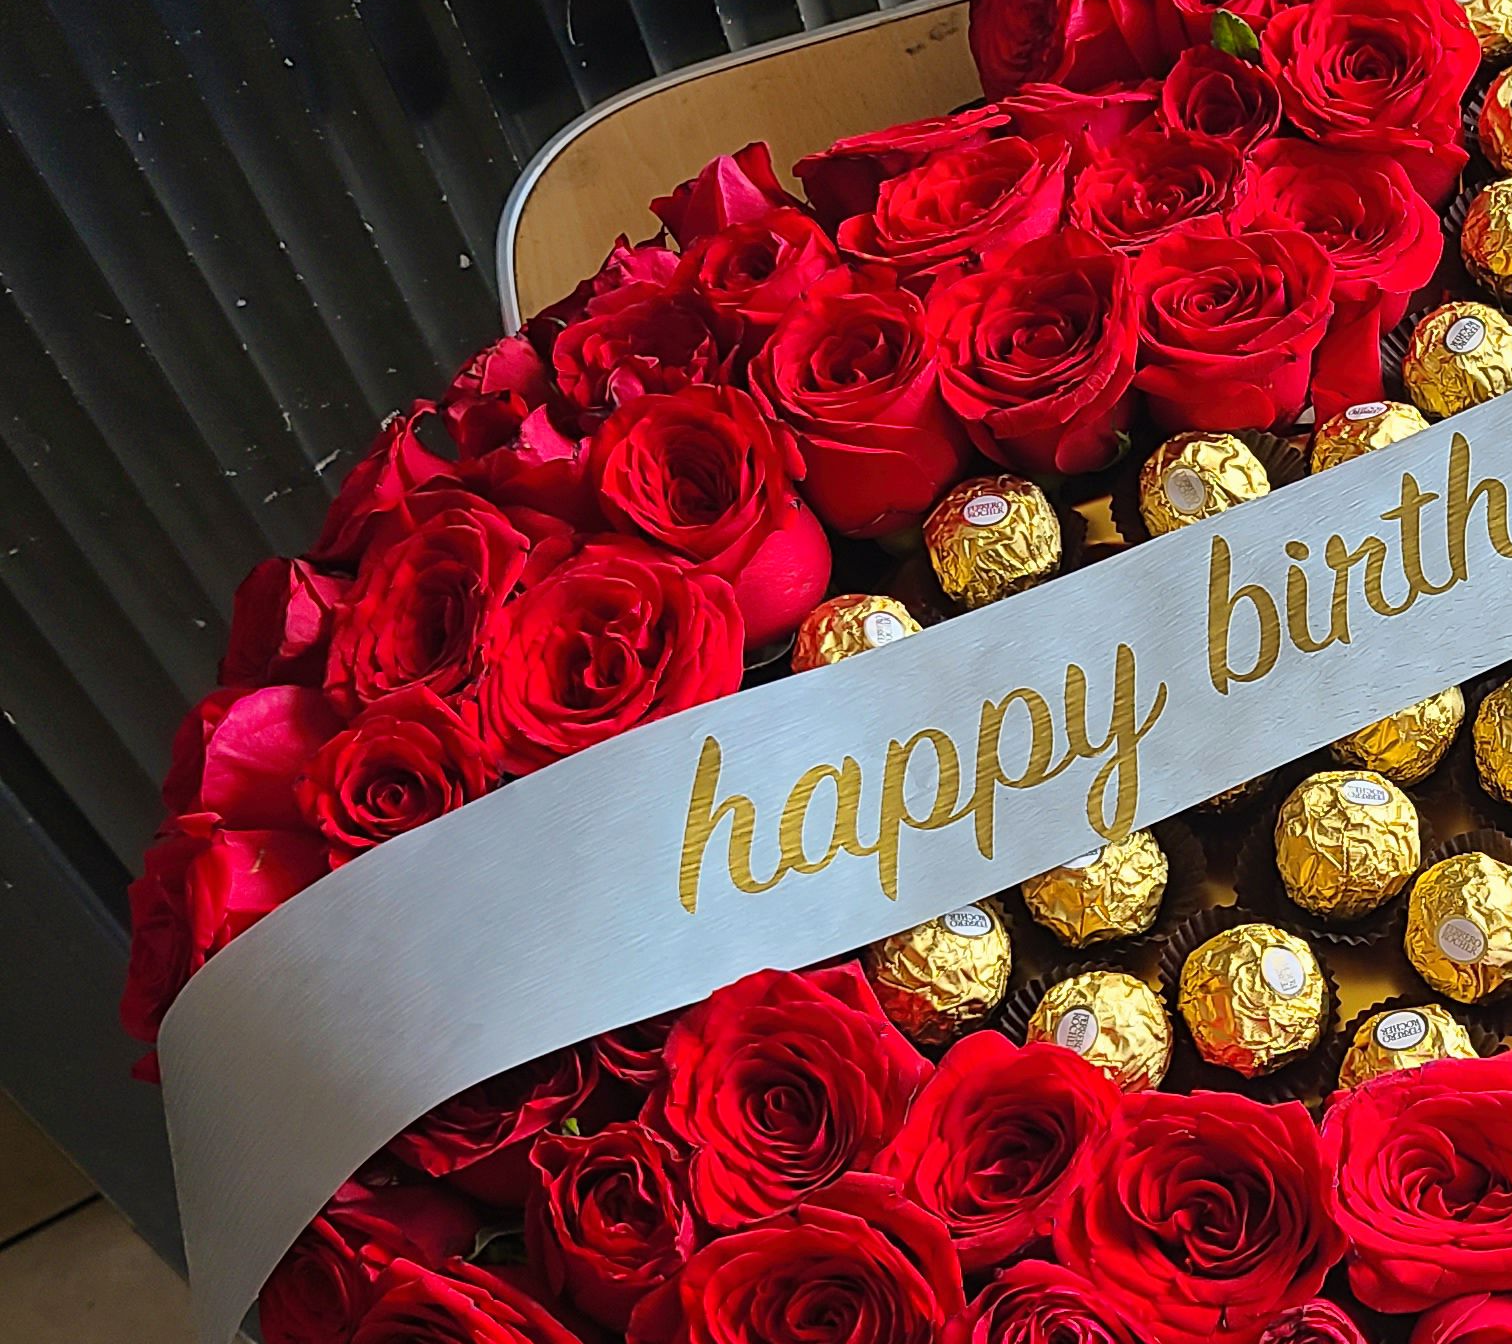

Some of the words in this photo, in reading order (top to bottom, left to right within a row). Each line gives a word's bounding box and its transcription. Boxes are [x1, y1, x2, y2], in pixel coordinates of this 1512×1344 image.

[1450, 321, 1476, 346] ROCHER
[1456, 324, 1481, 350] FERRERO
[966, 502, 1004, 512] FERRERO
[966, 508, 1005, 518] ROCHER
[677, 642, 1168, 915] happy
[948, 913, 986, 922] ROCHER
[1441, 934, 1478, 955] ROCHER
[1446, 924, 1482, 947] FERRERO
[1067, 1012, 1079, 1046] ROCHE
[1380, 1019, 1420, 1035] ROCHER
[1382, 1026, 1422, 1043] FERRERO
